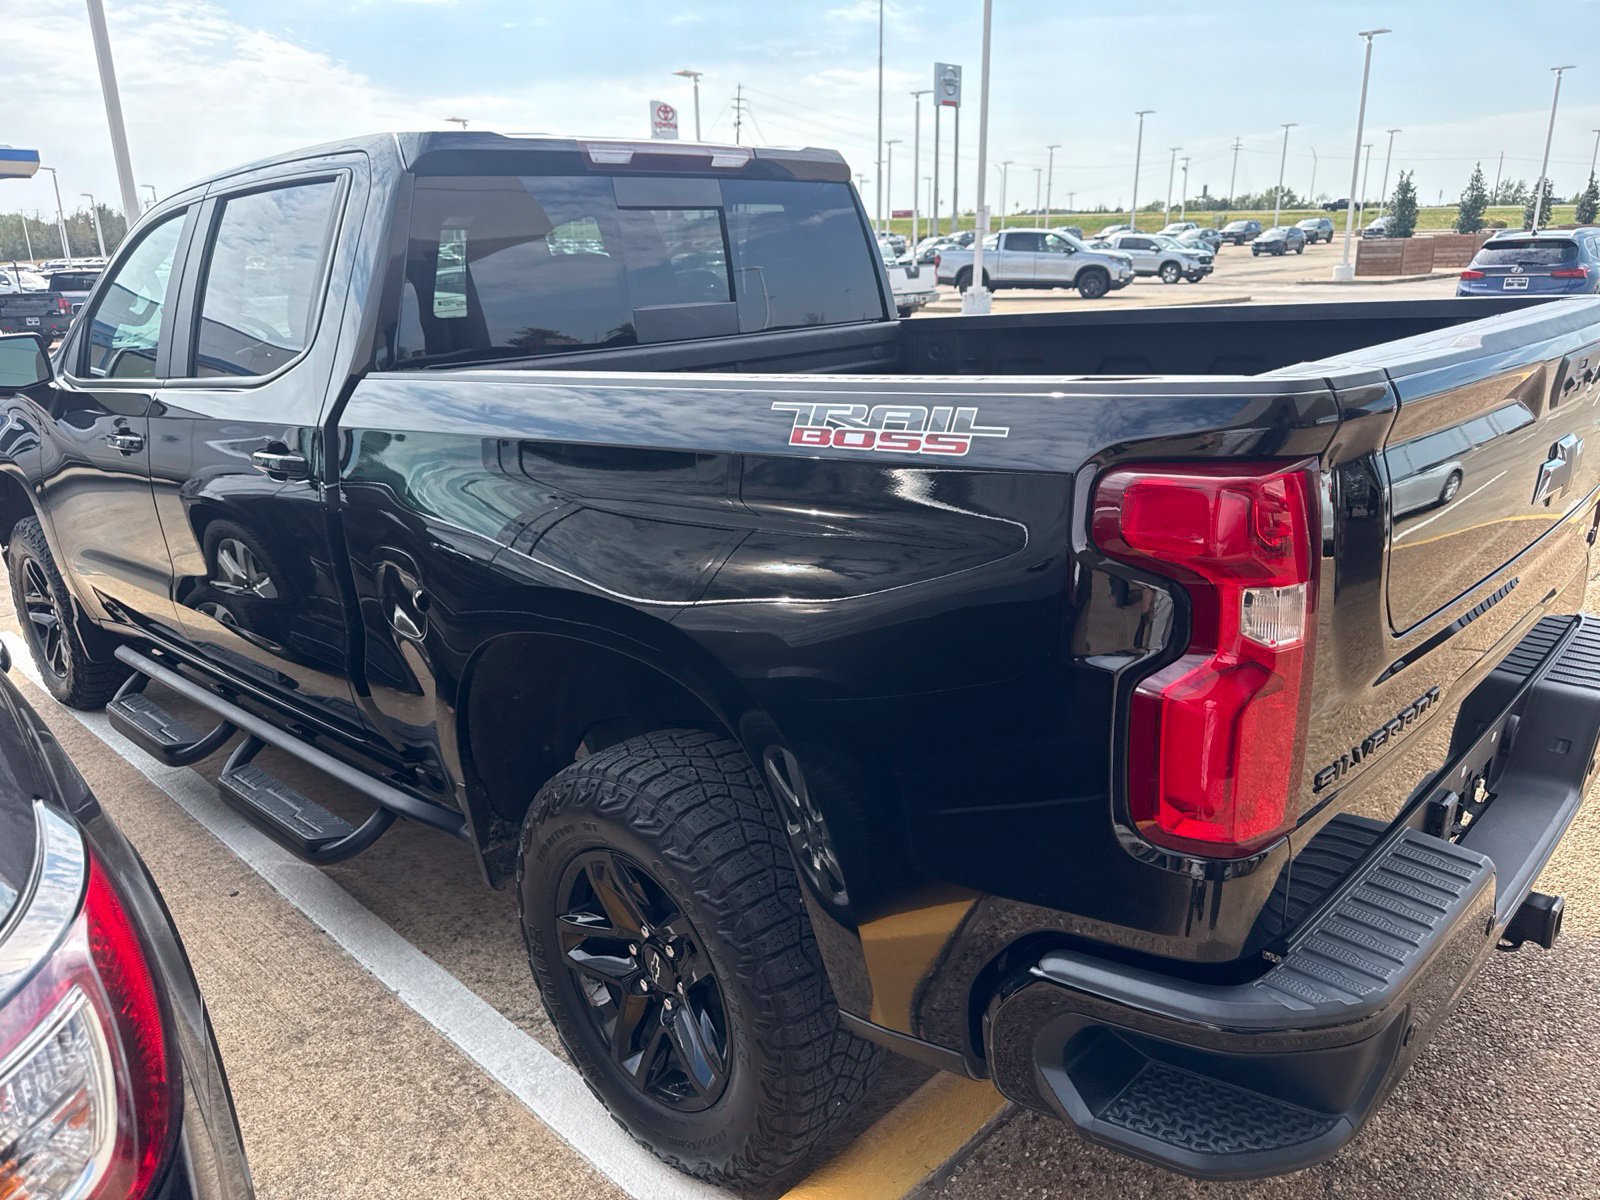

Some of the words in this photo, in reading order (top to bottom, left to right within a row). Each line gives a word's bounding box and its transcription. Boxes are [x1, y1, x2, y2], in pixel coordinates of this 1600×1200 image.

[654, 121, 678, 129] TOYOTA
[771, 401, 1010, 438] TRAIL
[788, 426, 973, 457] BOSS
[1313, 685, 1440, 794] SILVERADO
